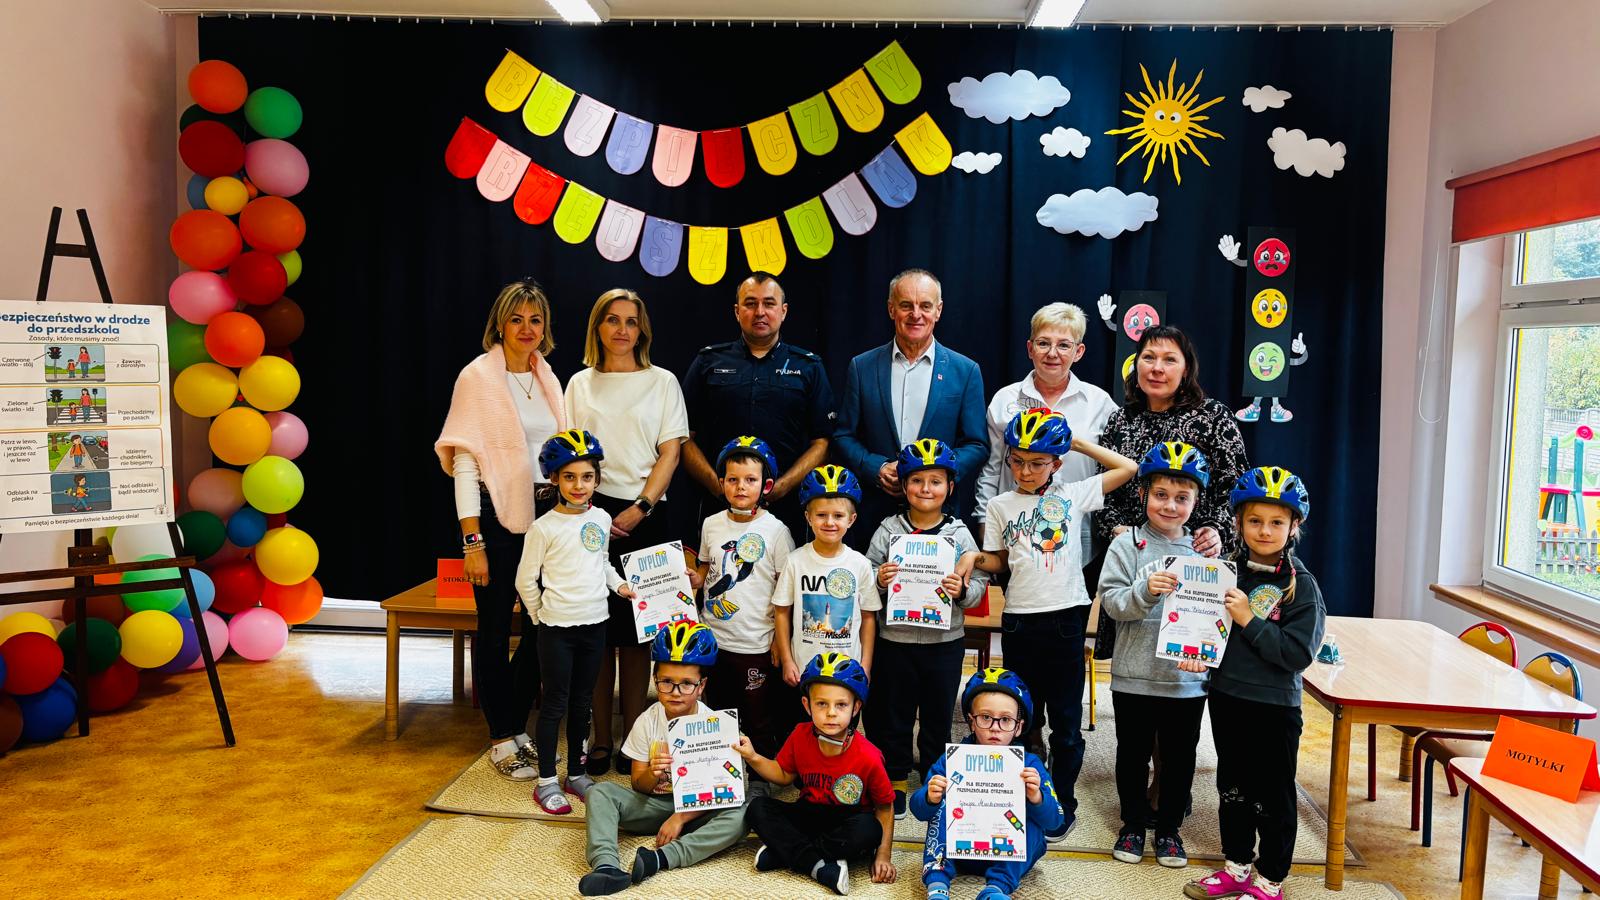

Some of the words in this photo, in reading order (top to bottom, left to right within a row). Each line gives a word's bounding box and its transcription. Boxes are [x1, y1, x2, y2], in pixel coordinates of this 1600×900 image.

[494, 52, 910, 175] BEZPIECZNY
[454, 120, 944, 272] RZEDSZKOLAK
[0, 312, 92, 324] ezpieczeństwo
[95, 316, 106, 324] w
[109, 314, 150, 325] drodze
[27, 323, 43, 333] do
[46, 324, 120, 335] przedszkola
[905, 541, 938, 556] DYPLOM
[638, 553, 668, 572] DYPLOM
[1184, 564, 1219, 585] DYPLOM
[824, 631, 851, 639] Mission
[685, 720, 721, 737] DYPLOM
[965, 754, 1004, 773] DYPLOM
[1506, 749, 1565, 773] MOTYLKI
